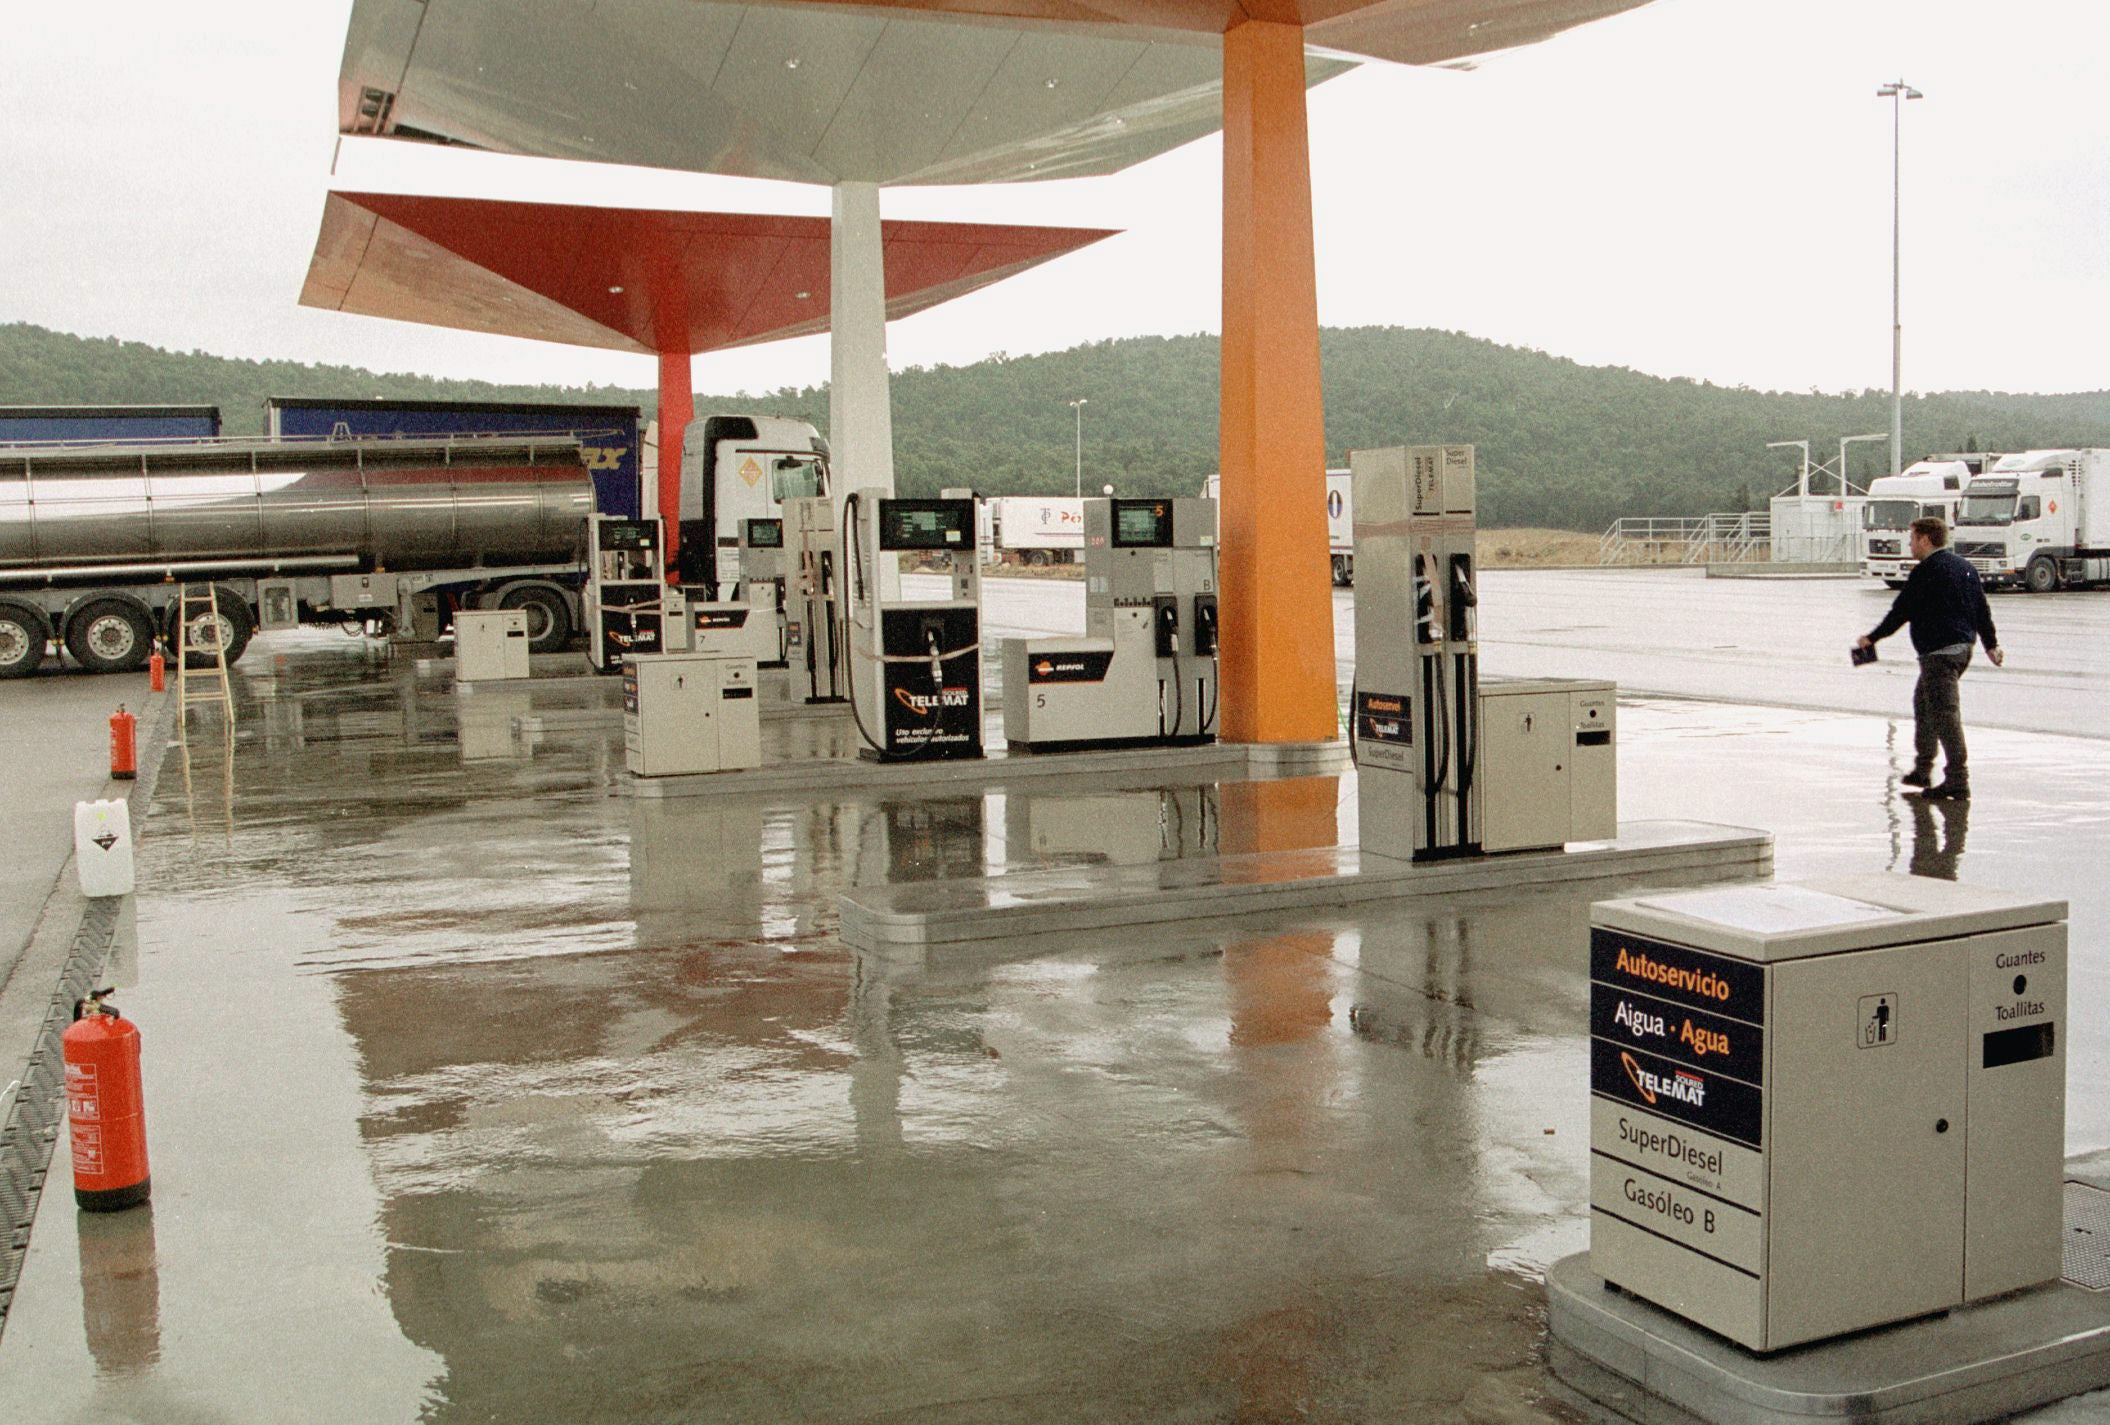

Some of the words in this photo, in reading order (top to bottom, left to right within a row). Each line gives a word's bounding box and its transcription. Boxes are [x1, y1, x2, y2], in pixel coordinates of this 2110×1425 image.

[619, 633, 656, 643] TELMAT
[909, 694, 969, 707] TELEMAT
[1036, 693, 1046, 708] 5
[1995, 950, 2046, 969] Guantes
[1616, 948, 1730, 1001] Autoservicio
[1995, 1001, 2045, 1021] Toallitas
[1615, 1000, 1666, 1037] Aigua
[1680, 1018, 1730, 1056] Agua
[1636, 1069, 1706, 1107] TELEMAT
[1619, 1117, 1723, 1176] SuperDiesel
[1624, 1177, 1694, 1225] Gasóleo
[1704, 1208, 1715, 1234] B
